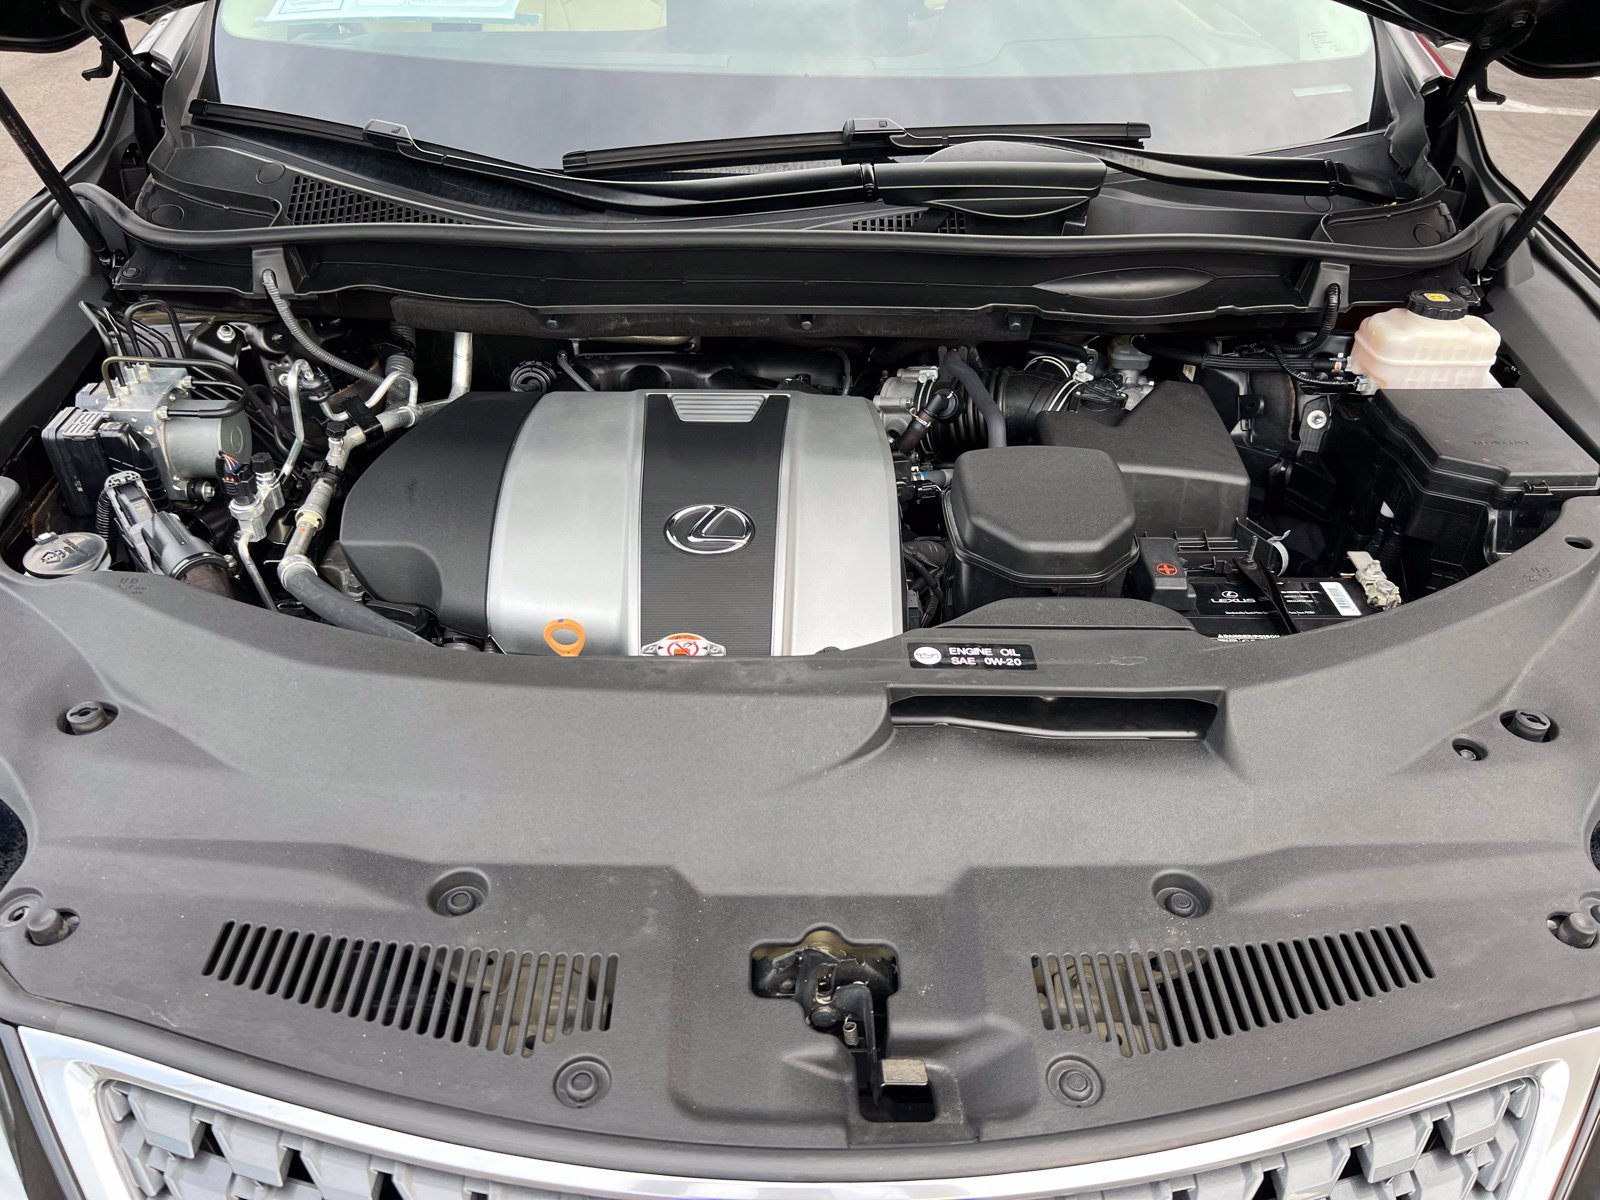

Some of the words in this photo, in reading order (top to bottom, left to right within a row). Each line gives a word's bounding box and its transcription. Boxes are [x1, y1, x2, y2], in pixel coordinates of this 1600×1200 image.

[948, 647, 993, 656] ENGINE
[1000, 648, 1021, 657] OIL
[950, 657, 977, 665] SAE
[984, 658, 1022, 666] 0W-20
